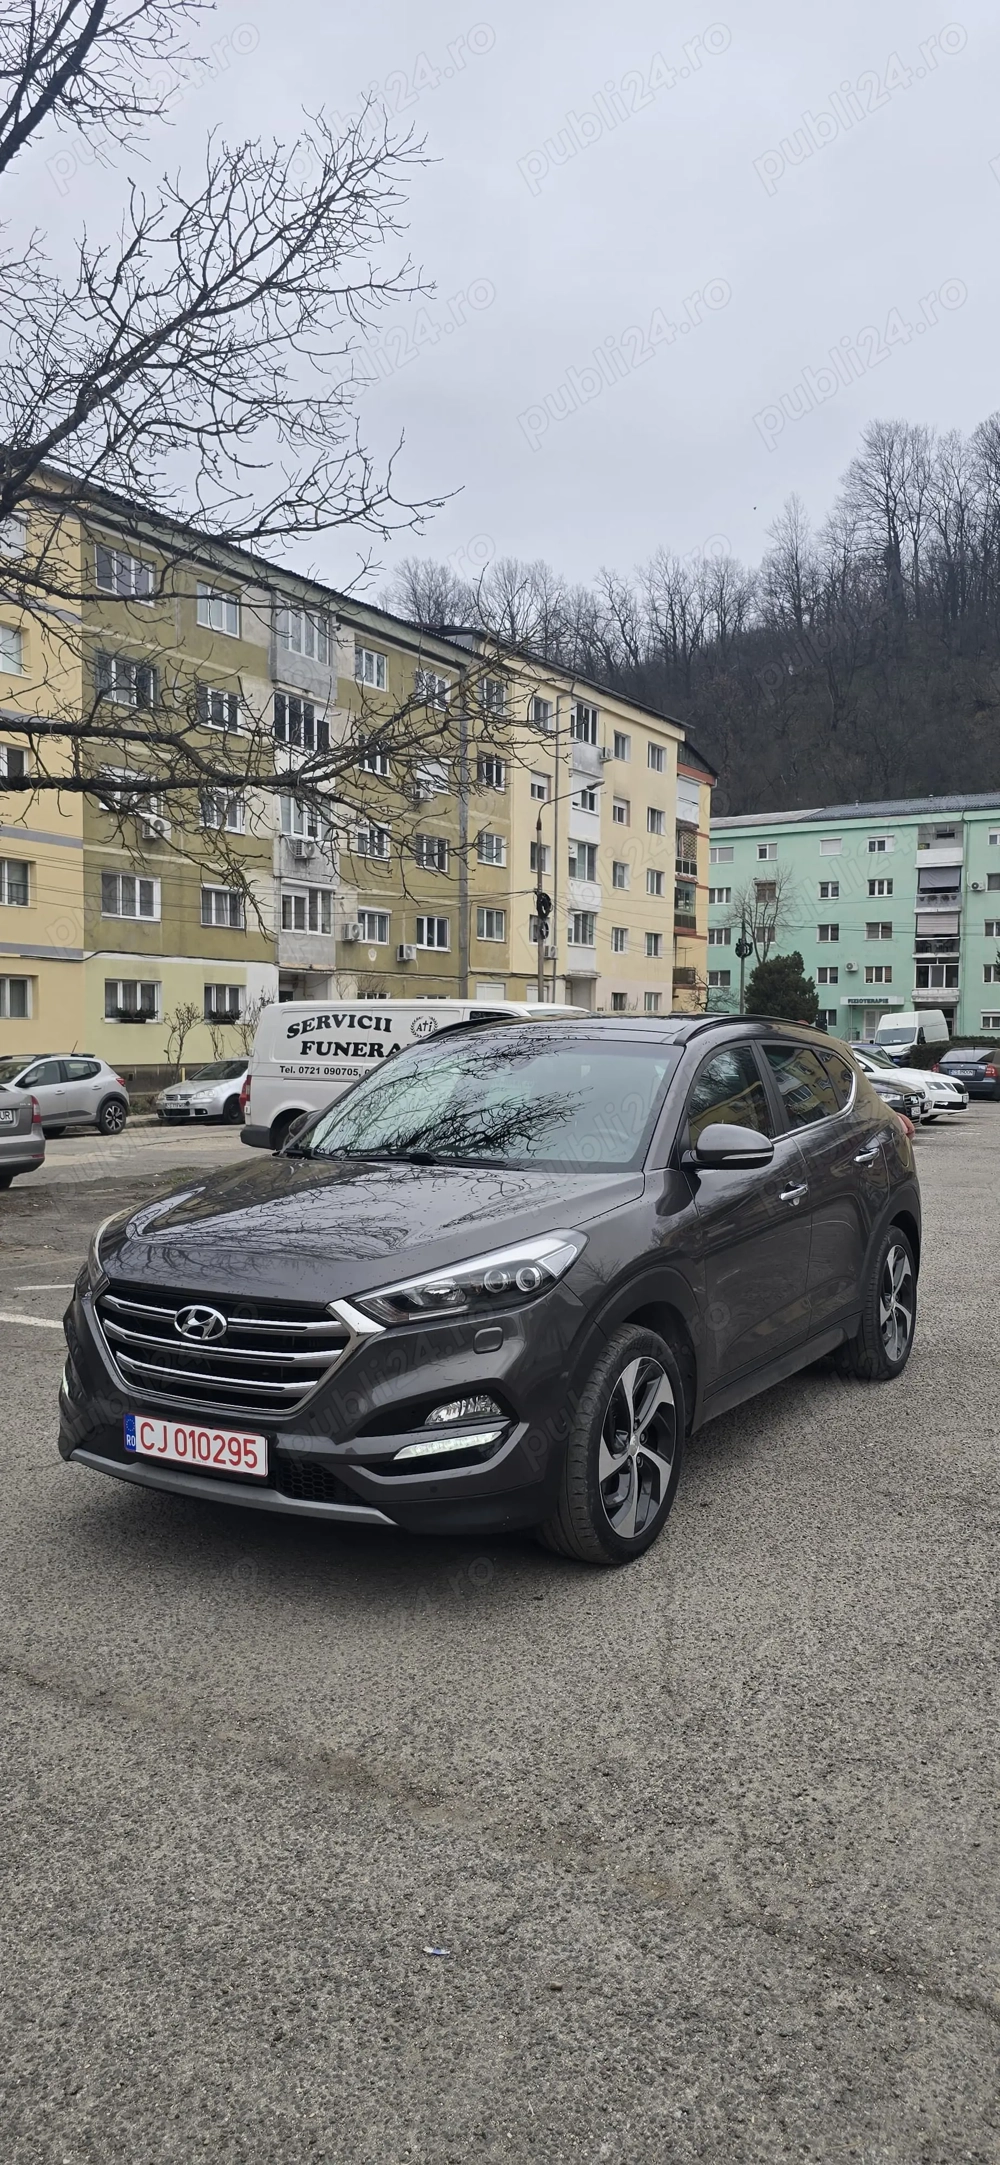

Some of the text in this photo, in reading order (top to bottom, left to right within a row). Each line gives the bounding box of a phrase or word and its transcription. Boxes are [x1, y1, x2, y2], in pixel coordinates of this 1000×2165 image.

[287, 1014, 392, 1039] SERVICII
[300, 1040, 410, 1058] FUNERA
[279, 1065, 296, 1074] Tel.
[298, 1066, 320, 1075] 0721
[324, 1067, 362, 1077] 090705,
[126, 1434, 136, 1447] RO
[140, 1421, 258, 1469] CJ 010295
